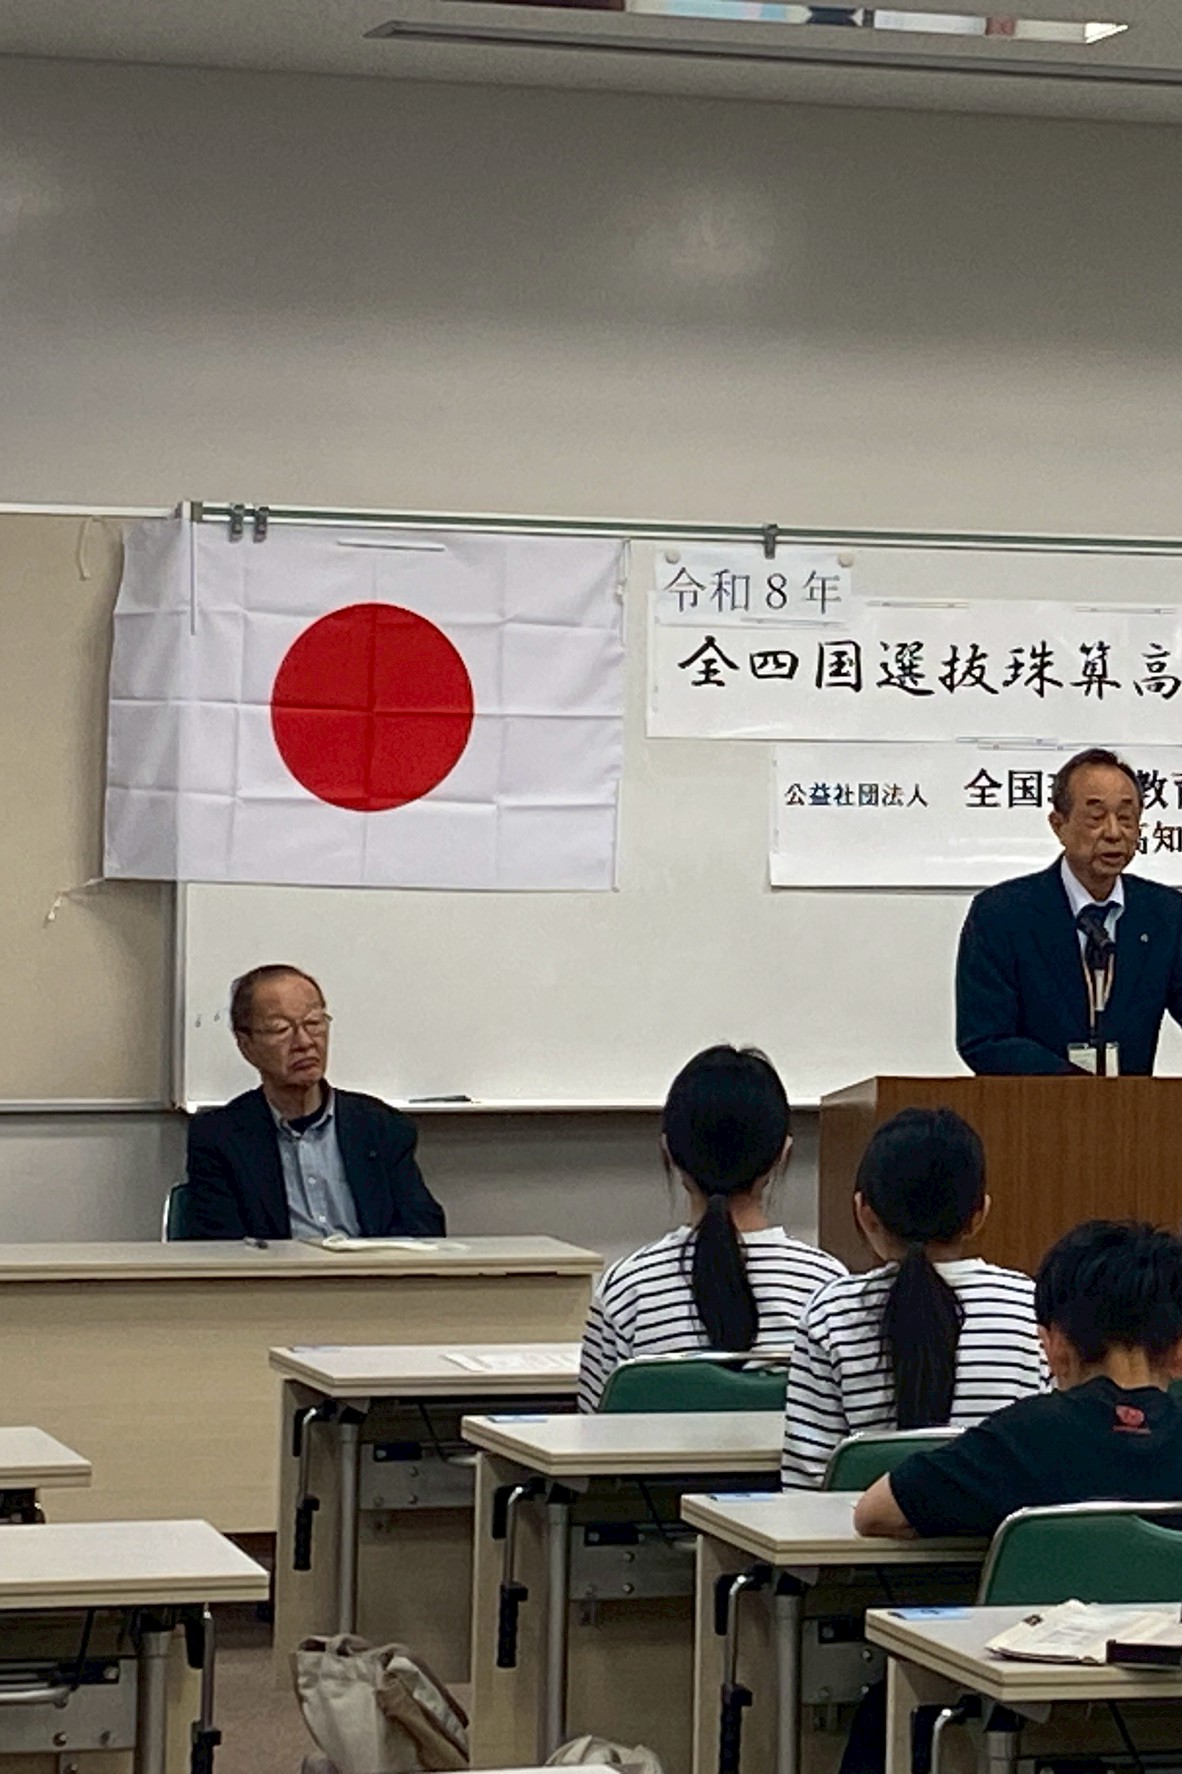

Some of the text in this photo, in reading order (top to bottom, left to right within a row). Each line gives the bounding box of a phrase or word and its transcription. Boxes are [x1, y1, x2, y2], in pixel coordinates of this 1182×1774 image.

[664, 566, 842, 614] 令和8年
[784, 782, 928, 808] 公益社団法人
